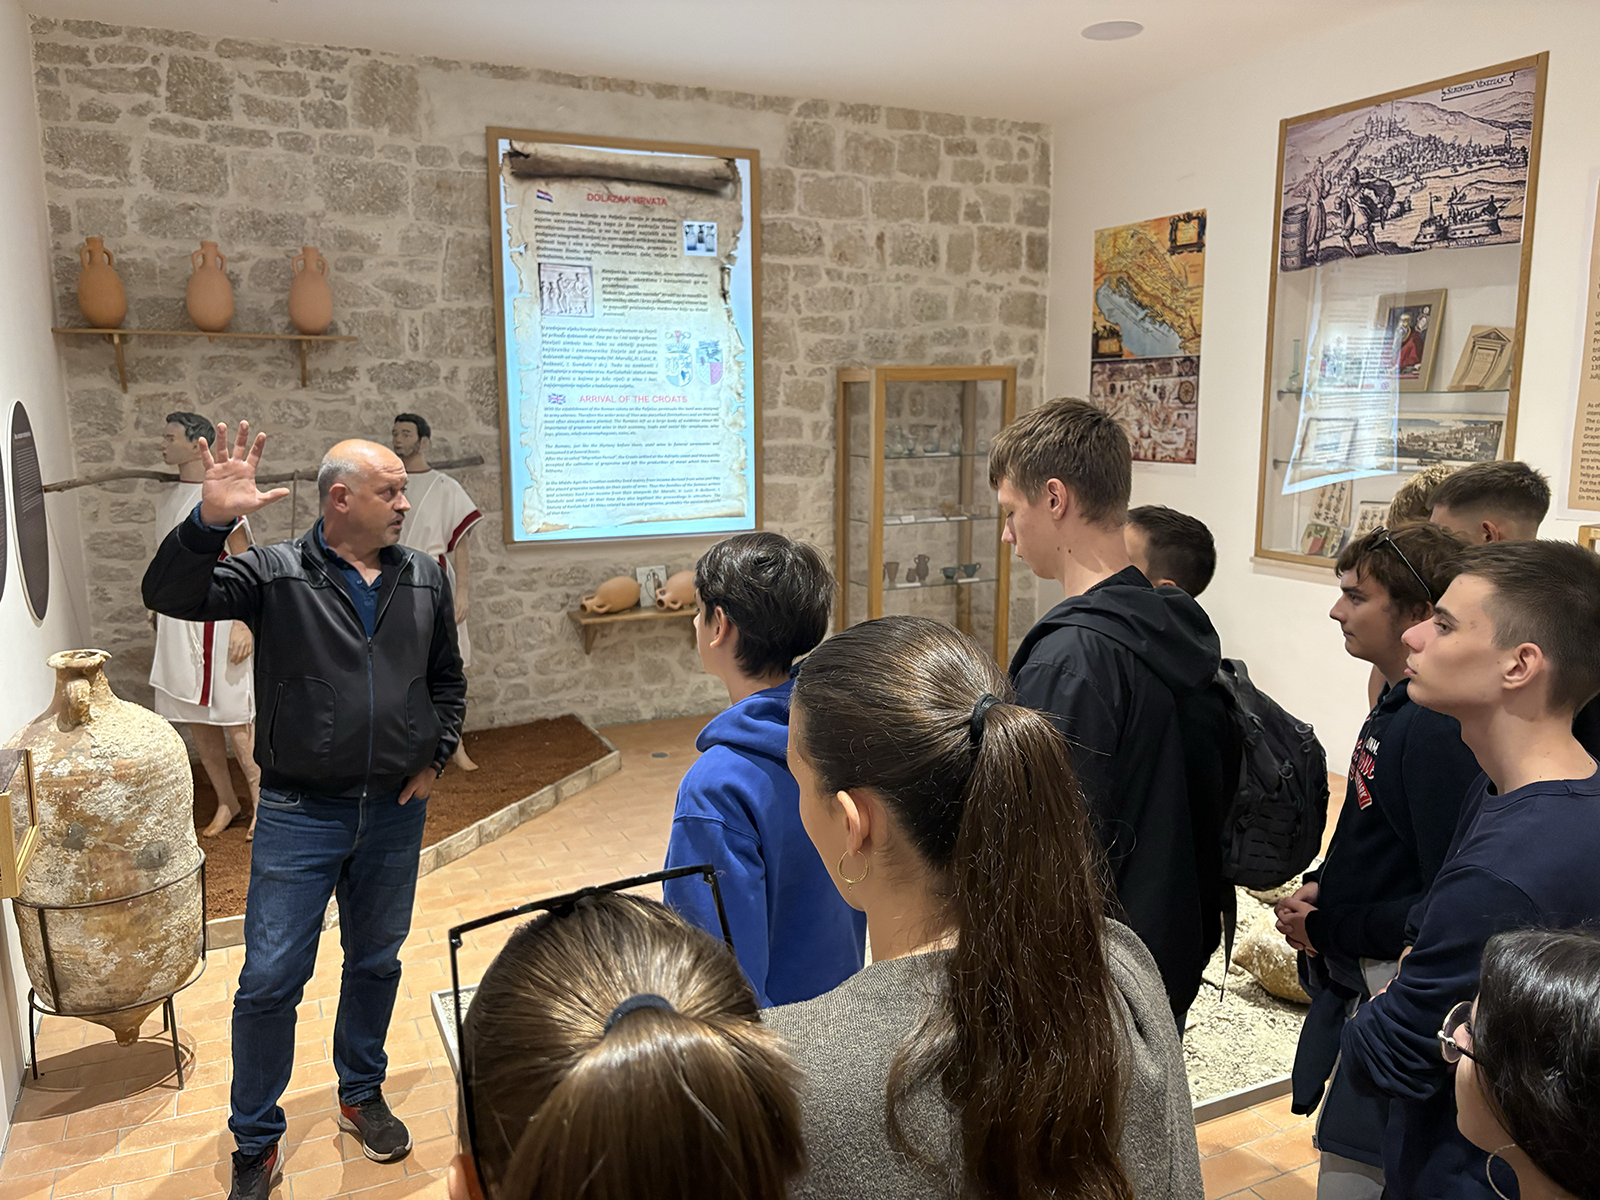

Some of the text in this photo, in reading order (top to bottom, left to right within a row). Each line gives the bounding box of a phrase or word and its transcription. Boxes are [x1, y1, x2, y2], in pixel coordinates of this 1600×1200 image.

[587, 193, 668, 206] DOLAZAK HRVATA
[579, 395, 688, 403] ARRIVAL OF THE CROATS
